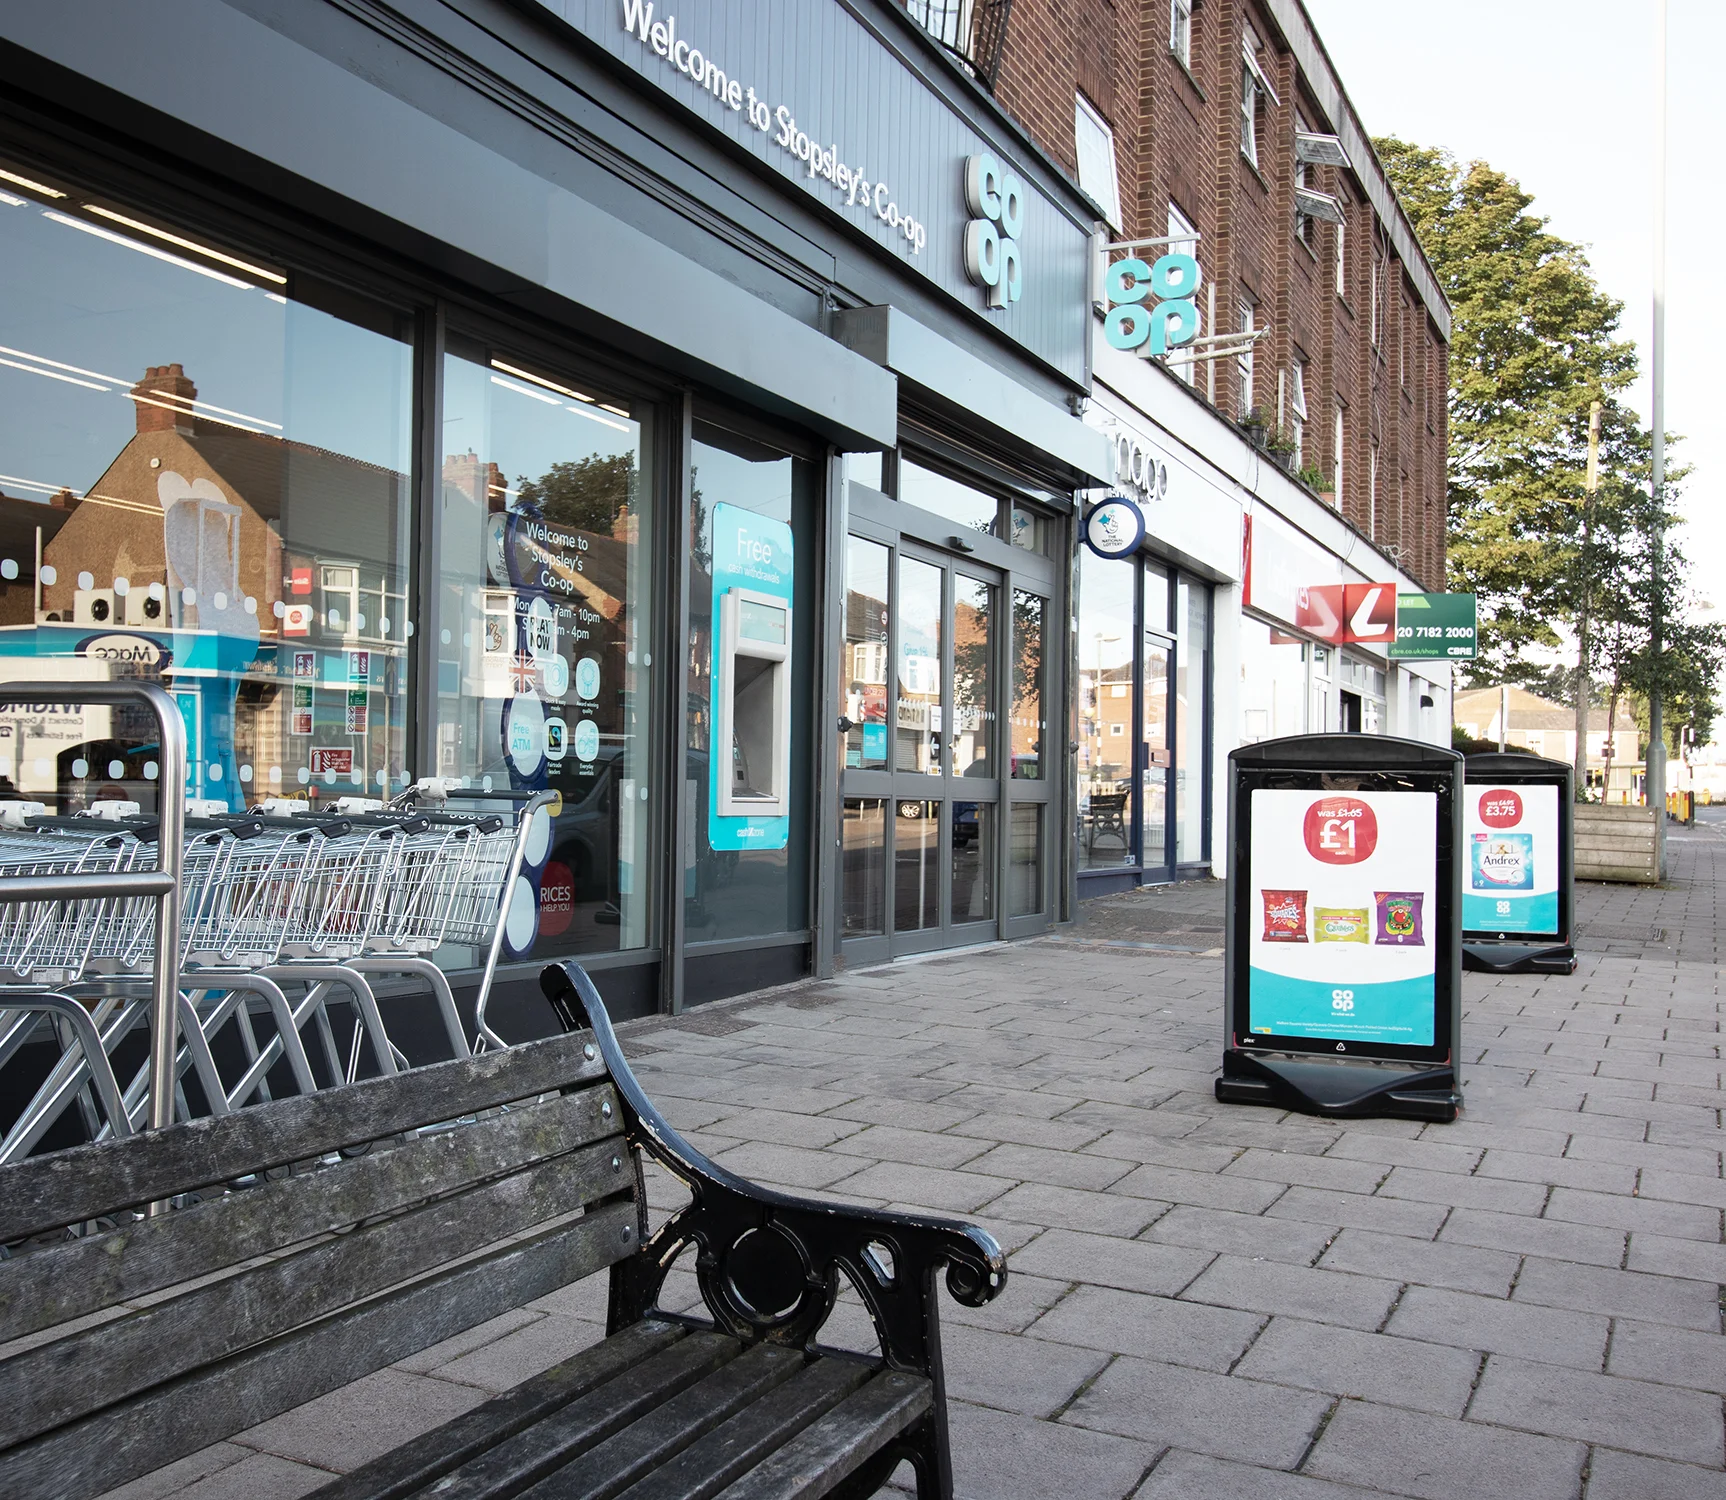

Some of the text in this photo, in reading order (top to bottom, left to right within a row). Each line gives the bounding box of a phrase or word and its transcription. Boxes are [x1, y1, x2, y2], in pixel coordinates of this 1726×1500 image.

[622, 0, 926, 255] Welcome to Stopsley's Co-op
[526, 521, 589, 551] Welcome to
[737, 527, 772, 565] Free
[531, 546, 583, 574] Stopsley's
[728, 563, 743, 575] cash
[541, 570, 574, 595] Co-op
[554, 603, 572, 619] 7am
[578, 608, 600, 625] 10pm
[571, 626, 590, 642] 4pm
[1397, 627, 1474, 638] 20 7182 2000
[1446, 647, 1473, 655] CBRE
[513, 722, 530, 734] Free
[512, 738, 531, 751] ATM
[1485, 806, 1516, 816] £3.75
[1319, 819, 1356, 849] £1
[1483, 855, 1520, 866] Andrex
[540, 886, 571, 902] RICES
[543, 902, 570, 912] HELP YOU
